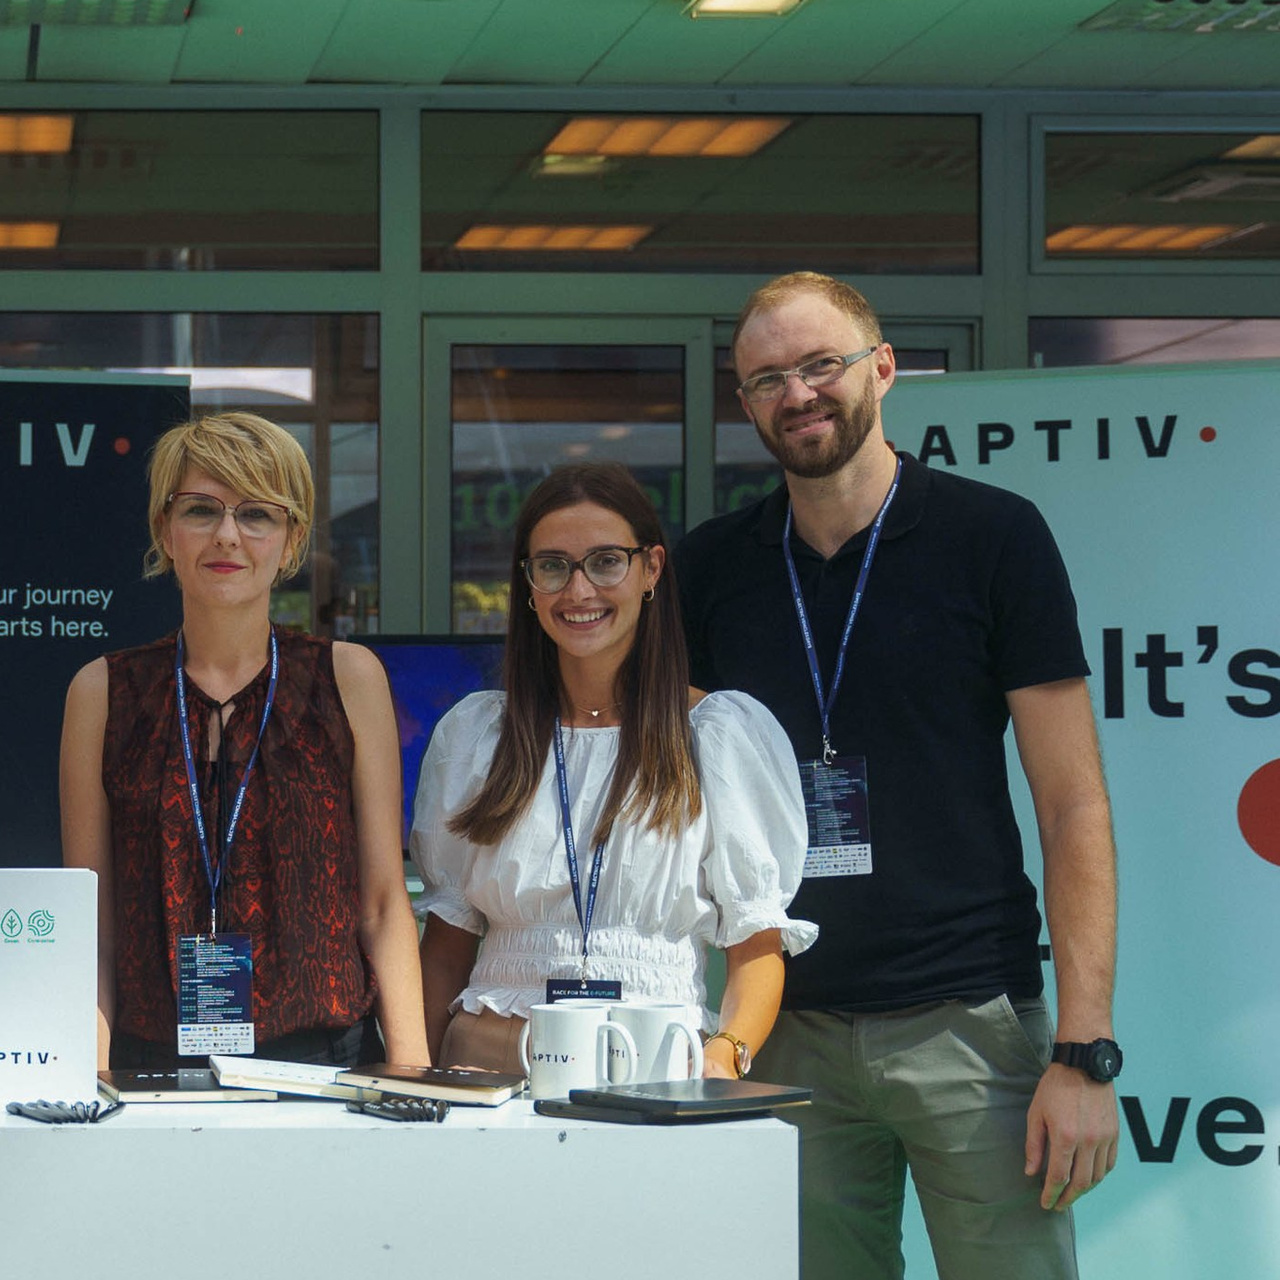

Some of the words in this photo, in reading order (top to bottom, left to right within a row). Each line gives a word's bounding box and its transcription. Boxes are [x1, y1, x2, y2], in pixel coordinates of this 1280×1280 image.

[919, 415, 1178, 466] APTIV
[23, 582, 114, 611] journey
[50, 616, 109, 637] here.
[1102, 625, 1280, 719] It's
[1119, 1095, 1280, 1167] ve
